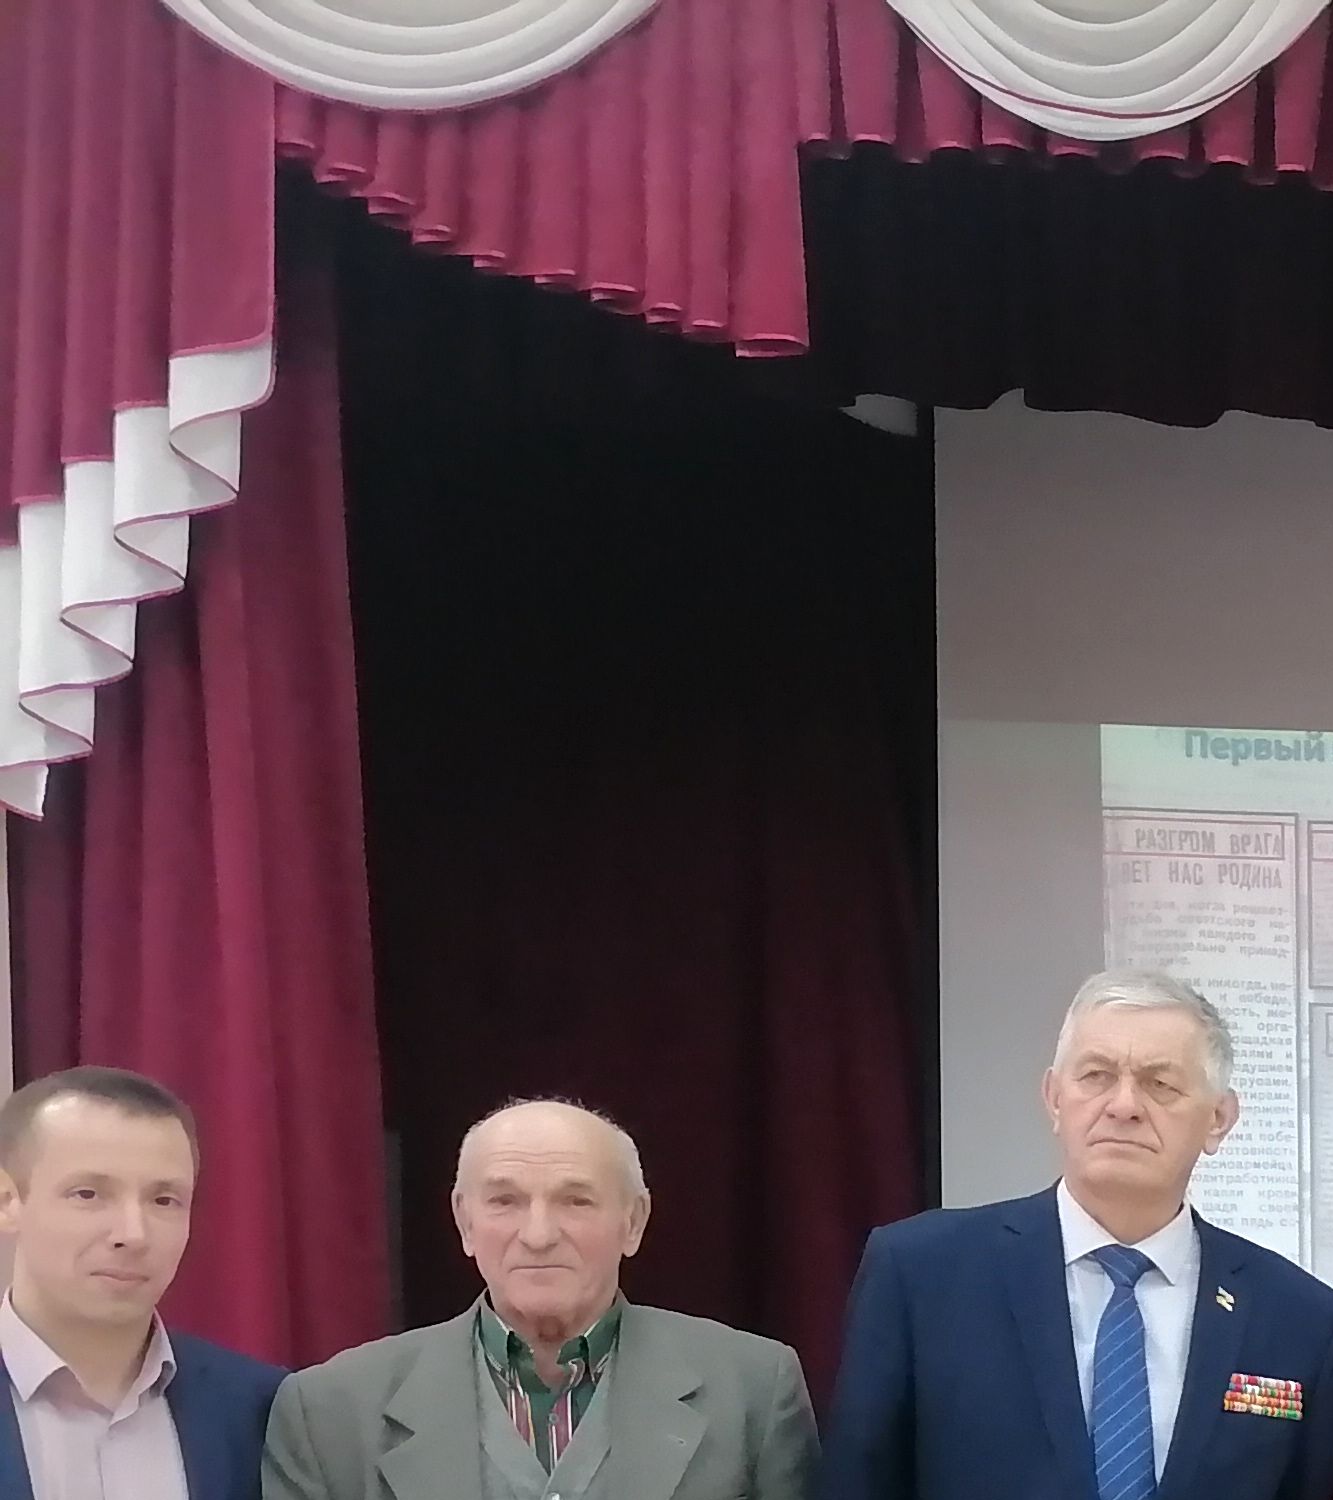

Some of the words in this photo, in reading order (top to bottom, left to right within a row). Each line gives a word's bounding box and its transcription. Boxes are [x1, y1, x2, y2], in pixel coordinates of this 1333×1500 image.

[1185, 730, 1326, 766] Первый
[1134, 828, 1216, 853] РАЗГРОМ
[1229, 833, 1283, 856] ВРАГА
[1168, 861, 1204, 886] НАС
[1218, 862, 1283, 890] РОДИНА
